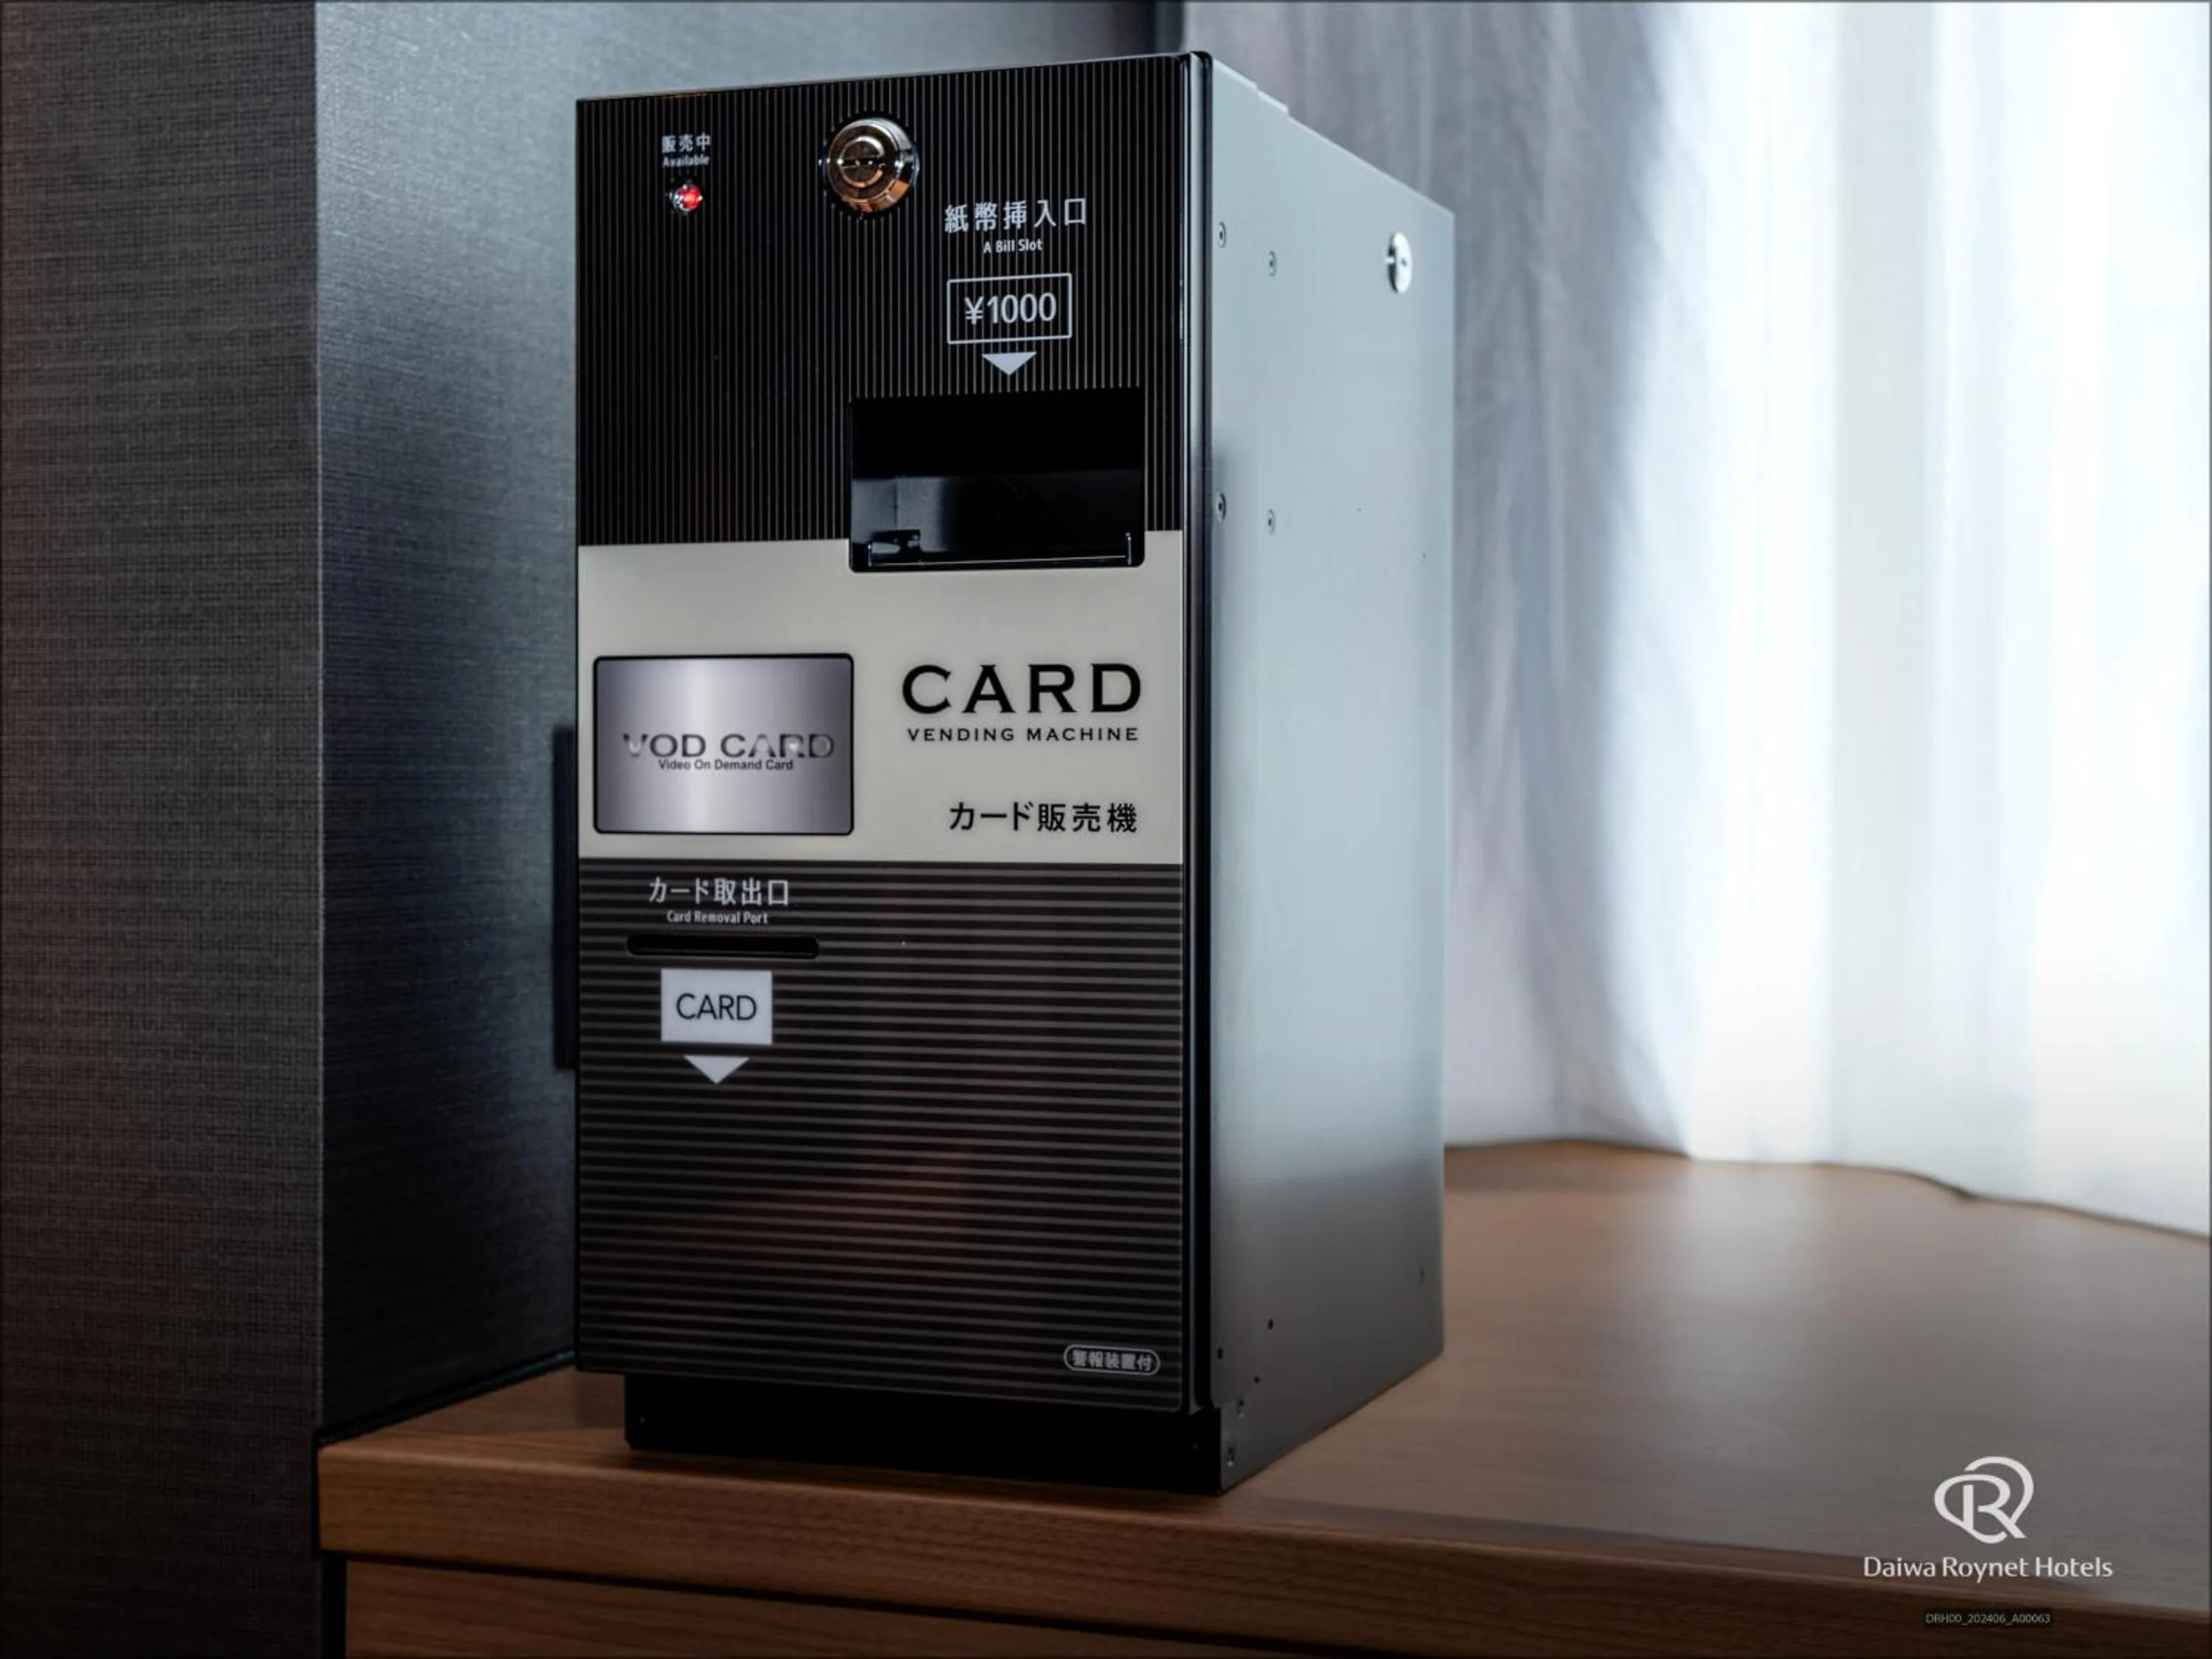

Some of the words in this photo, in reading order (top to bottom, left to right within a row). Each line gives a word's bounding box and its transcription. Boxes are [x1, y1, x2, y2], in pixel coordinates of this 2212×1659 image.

[661, 131, 711, 153] 販売中
[662, 153, 710, 168] Available
[945, 198, 1087, 233] 紙幣挿入口
[983, 241, 992, 254] A
[995, 240, 1015, 253] Bill
[1018, 238, 1043, 252] Slot
[964, 293, 1057, 324] ¥1000
[902, 663, 1141, 714] CARD
[622, 733, 706, 758] VOD
[720, 733, 835, 759] CARD
[908, 727, 1015, 742] VENDING
[1026, 727, 1139, 741] MACHINE
[658, 759, 691, 771] Video
[694, 758, 711, 771] On
[714, 758, 762, 771] Demand
[765, 759, 793, 771] Card
[949, 801, 1138, 833] カード販売機
[649, 876, 790, 906] カード取出口
[667, 910, 691, 922] Card
[694, 911, 740, 923] Removal
[743, 911, 768, 925] Port
[676, 993, 757, 1021] CARD
